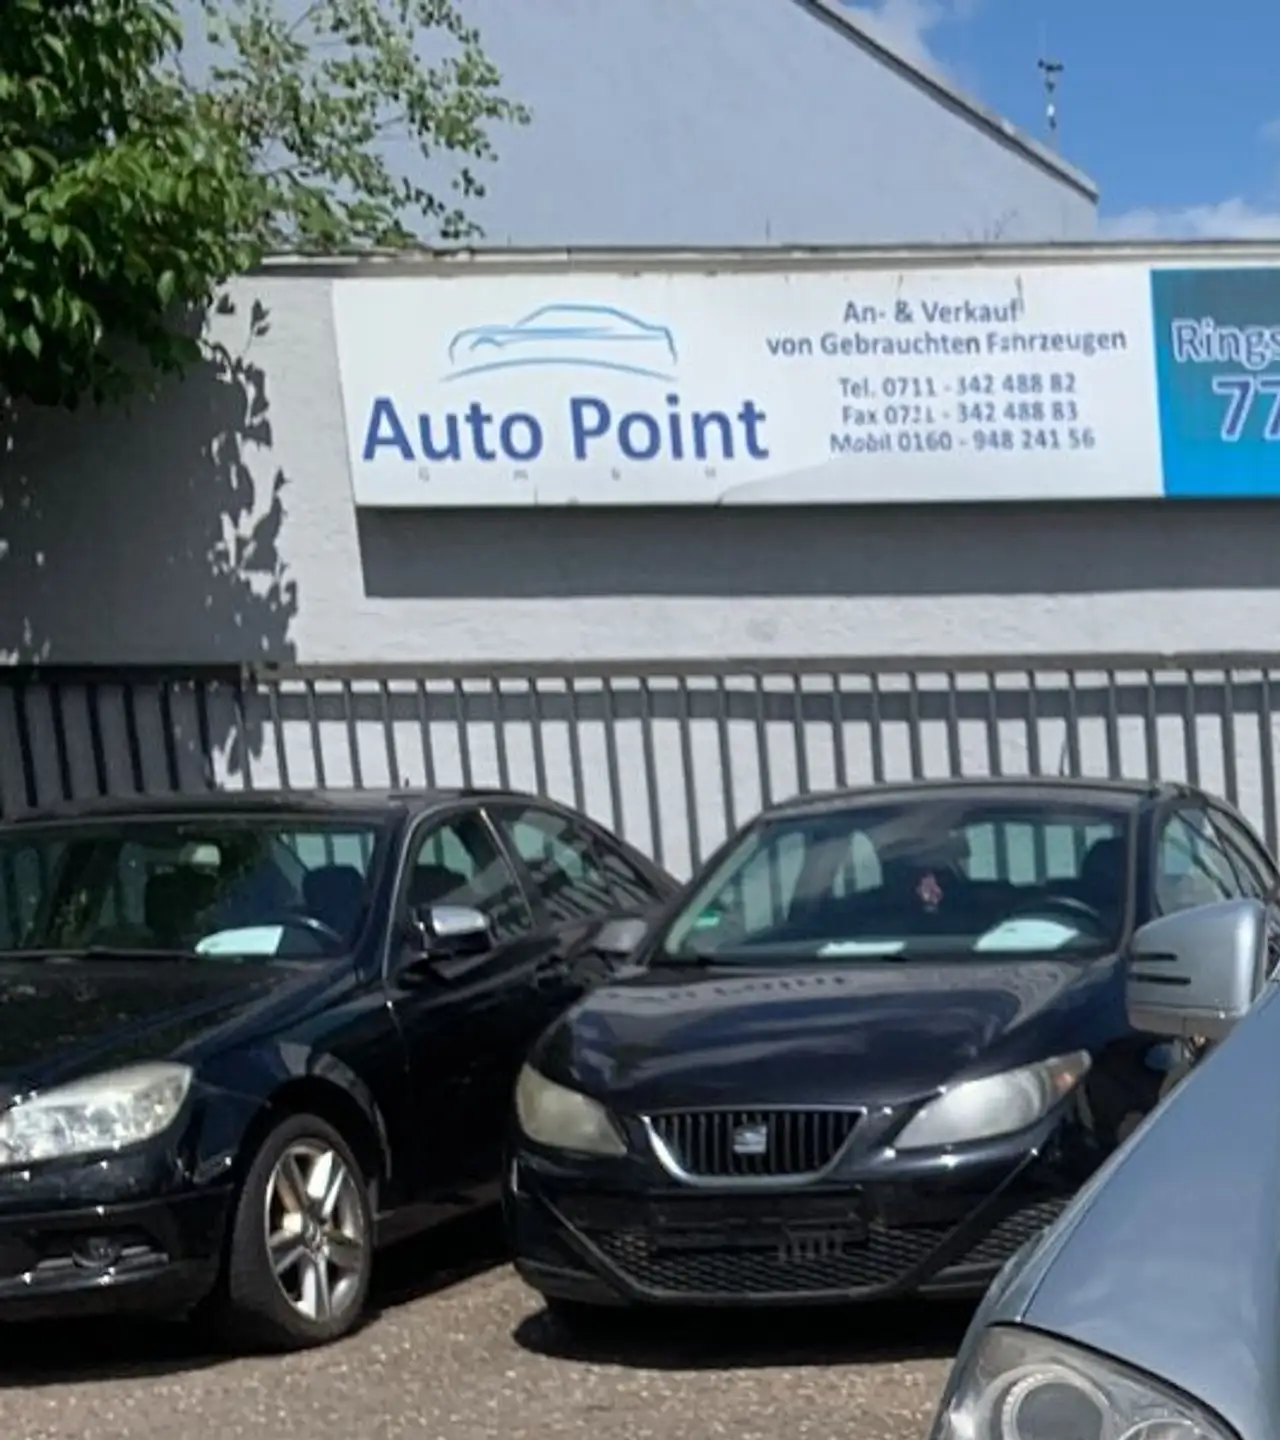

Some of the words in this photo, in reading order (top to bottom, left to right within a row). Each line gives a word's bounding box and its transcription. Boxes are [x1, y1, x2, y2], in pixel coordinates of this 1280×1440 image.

[844, 300, 886, 323] An-
[894, 300, 913, 323] &
[921, 299, 1018, 323] Verkauf
[766, 336, 813, 356] von
[820, 331, 980, 355] Gebrauchten
[986, 330, 1127, 356] Fahrzeugen
[839, 376, 876, 398] Tel.
[882, 376, 937, 398] 0711
[957, 373, 995, 396] 342
[1002, 372, 1043, 394] 488
[1050, 371, 1076, 394] 82
[842, 404, 878, 426] Fax
[957, 401, 996, 423] 342
[1003, 400, 1045, 422] 488
[363, 397, 544, 461] Auto
[569, 393, 770, 460] Point
[829, 432, 892, 453] Mobil
[898, 430, 952, 452] 0160
[973, 428, 1014, 452] 948
[1021, 428, 1060, 450] 241
[1068, 427, 1096, 450] 56
